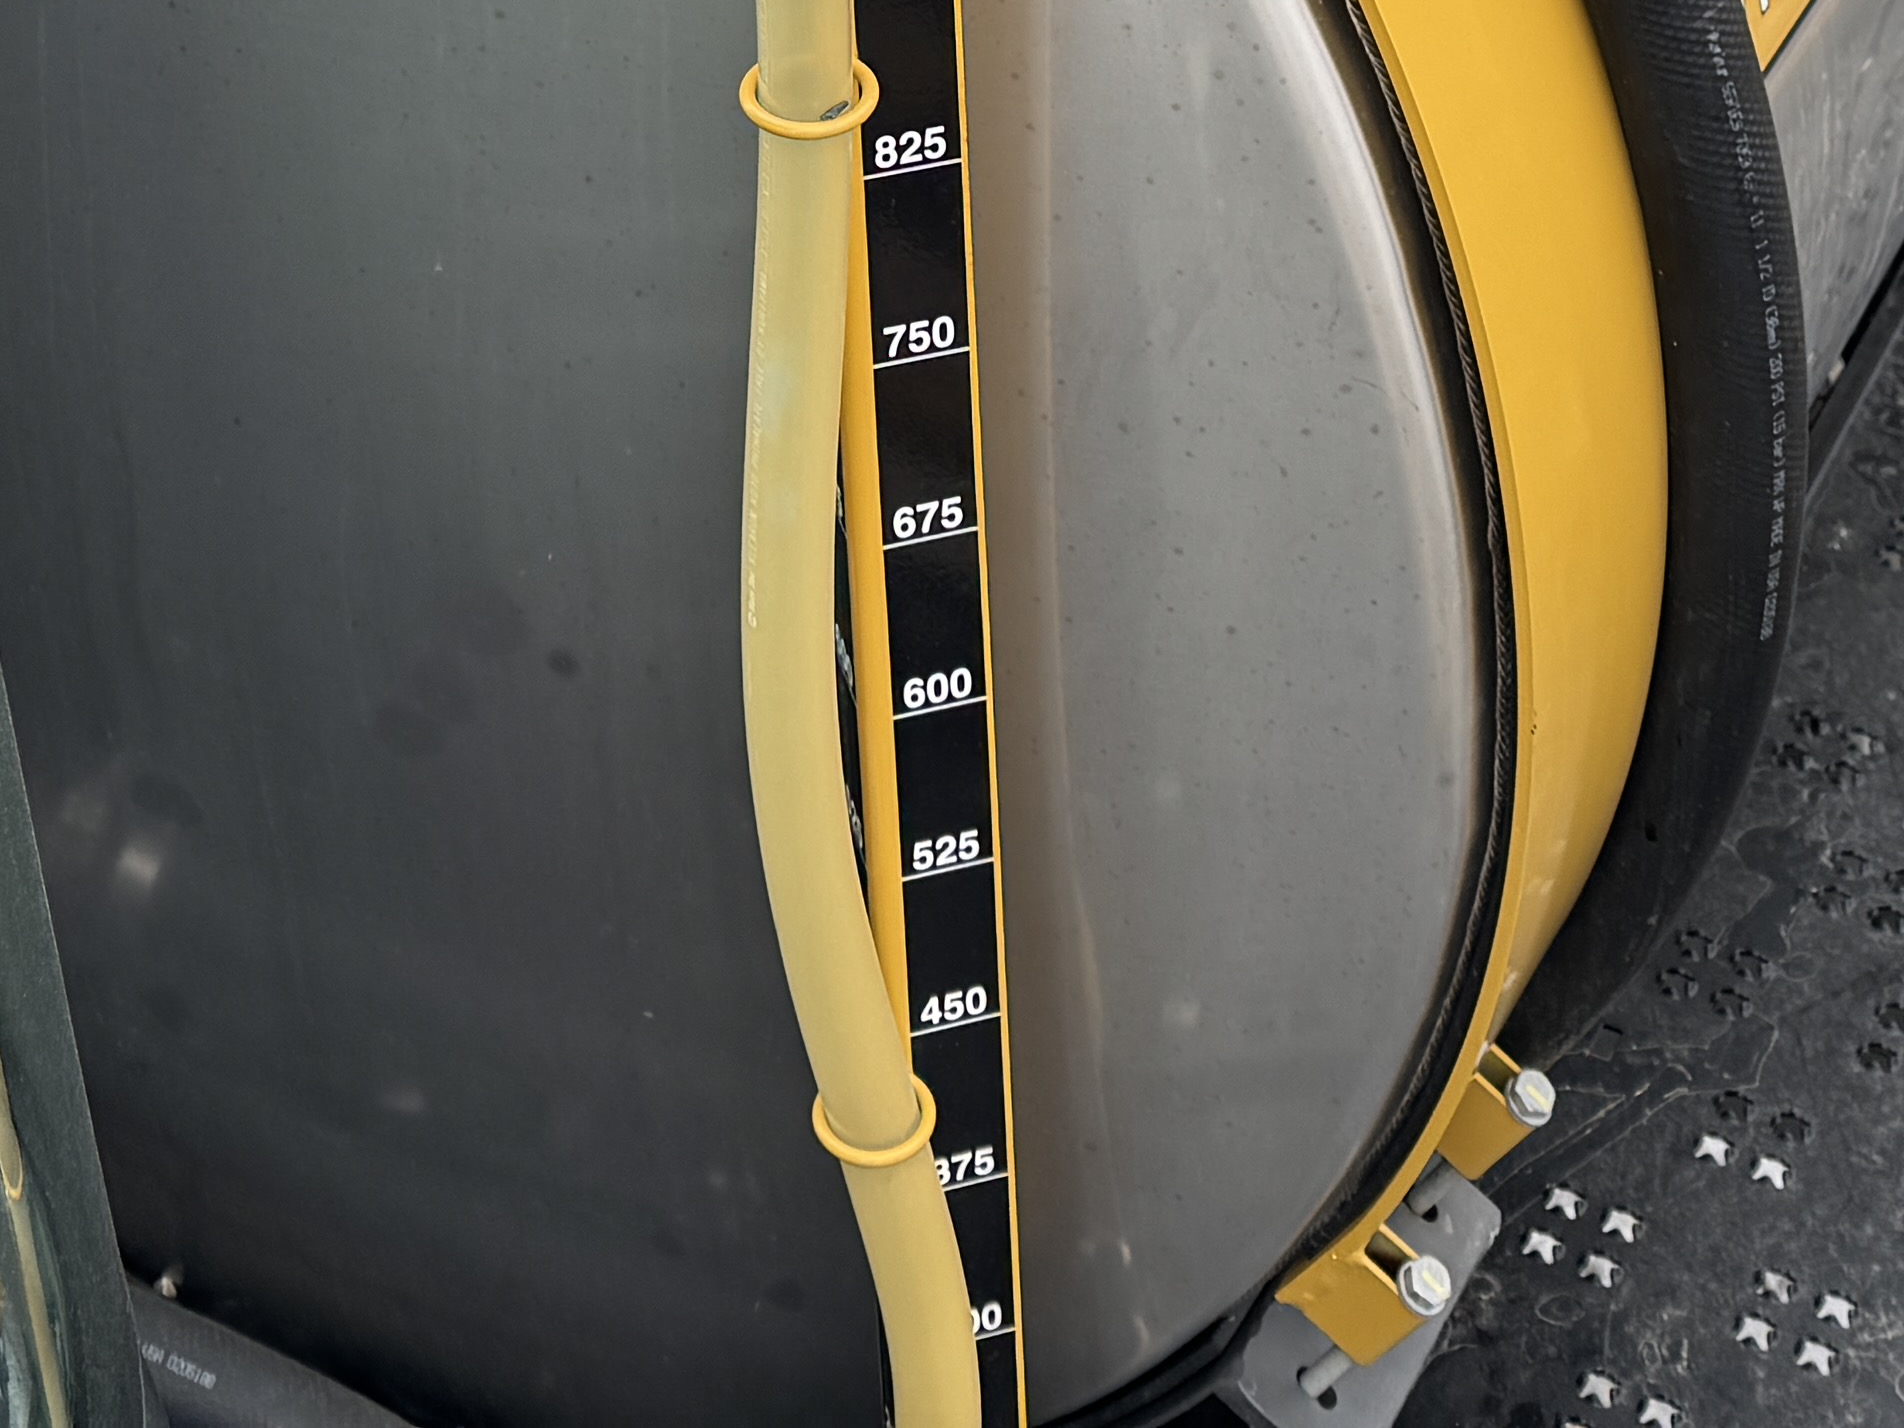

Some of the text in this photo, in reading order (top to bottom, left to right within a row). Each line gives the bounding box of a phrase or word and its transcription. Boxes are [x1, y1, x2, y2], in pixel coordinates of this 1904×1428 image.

[873, 126, 947, 169] 825
[882, 315, 955, 357] 750
[892, 496, 964, 539] 675
[903, 666, 973, 709] 600
[912, 830, 980, 871] 525
[920, 985, 987, 1025] 450
